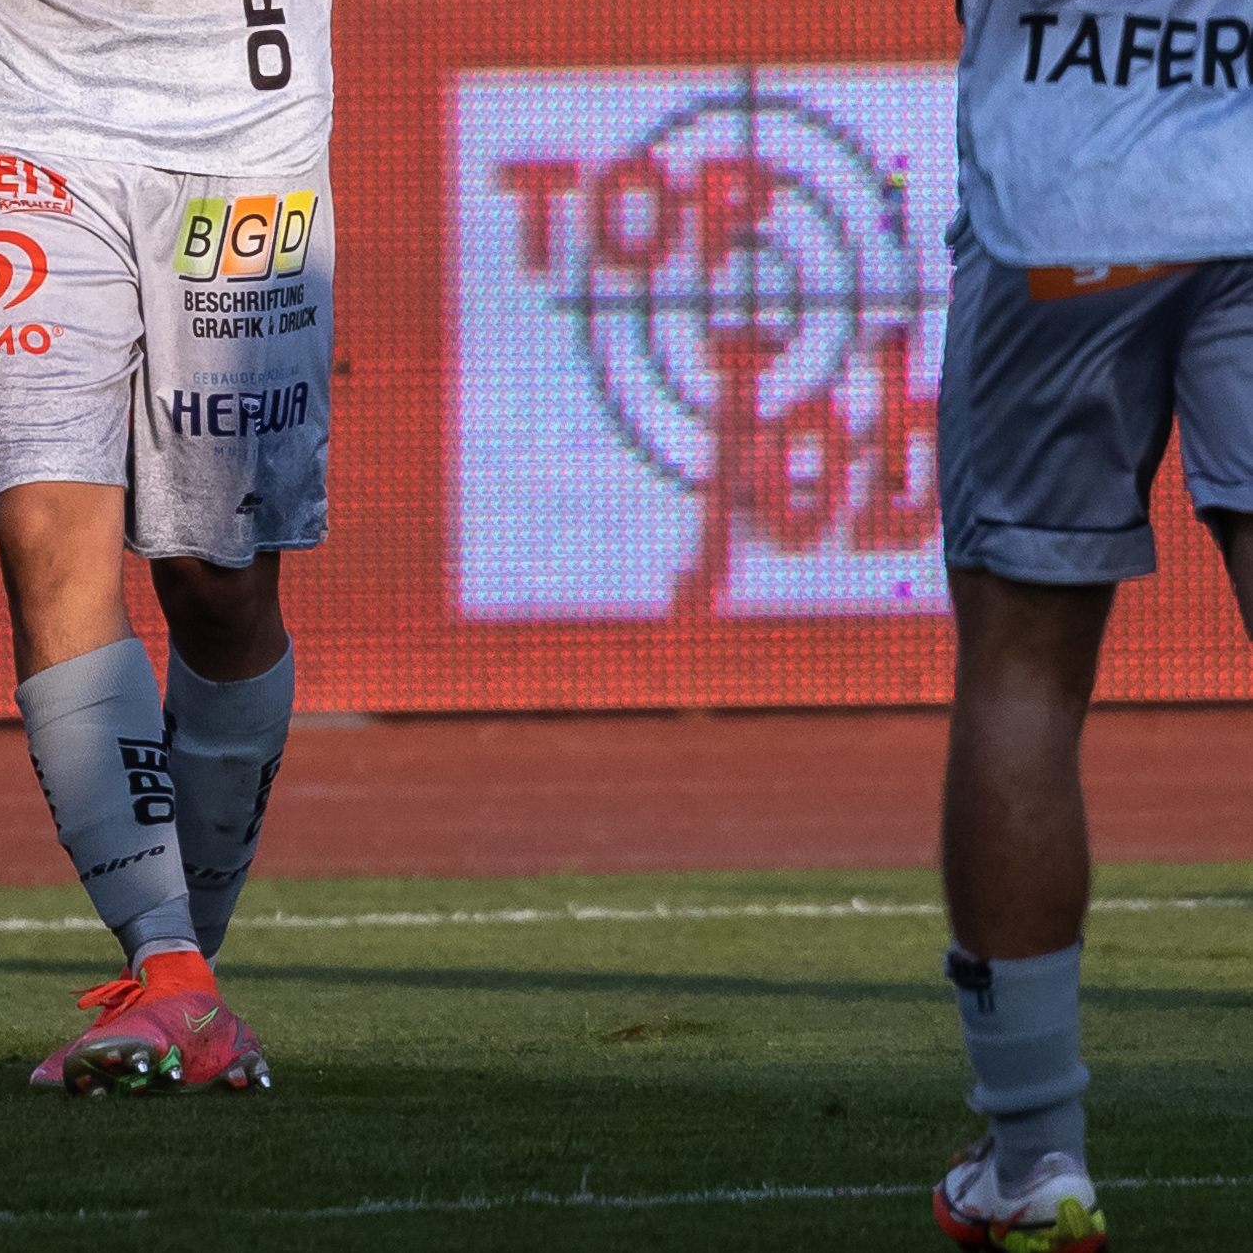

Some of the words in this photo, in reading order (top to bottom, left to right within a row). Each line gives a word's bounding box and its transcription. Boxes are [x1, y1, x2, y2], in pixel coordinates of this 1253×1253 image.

[1019, 13, 1253, 89] TAFER
[183, 209, 306, 259] BGD
[184, 283, 304, 313] BESCHRIFTUNG
[192, 316, 264, 339] GRAFIK
[278, 305, 317, 335] DRUCK
[116, 729, 177, 826] OPEL
